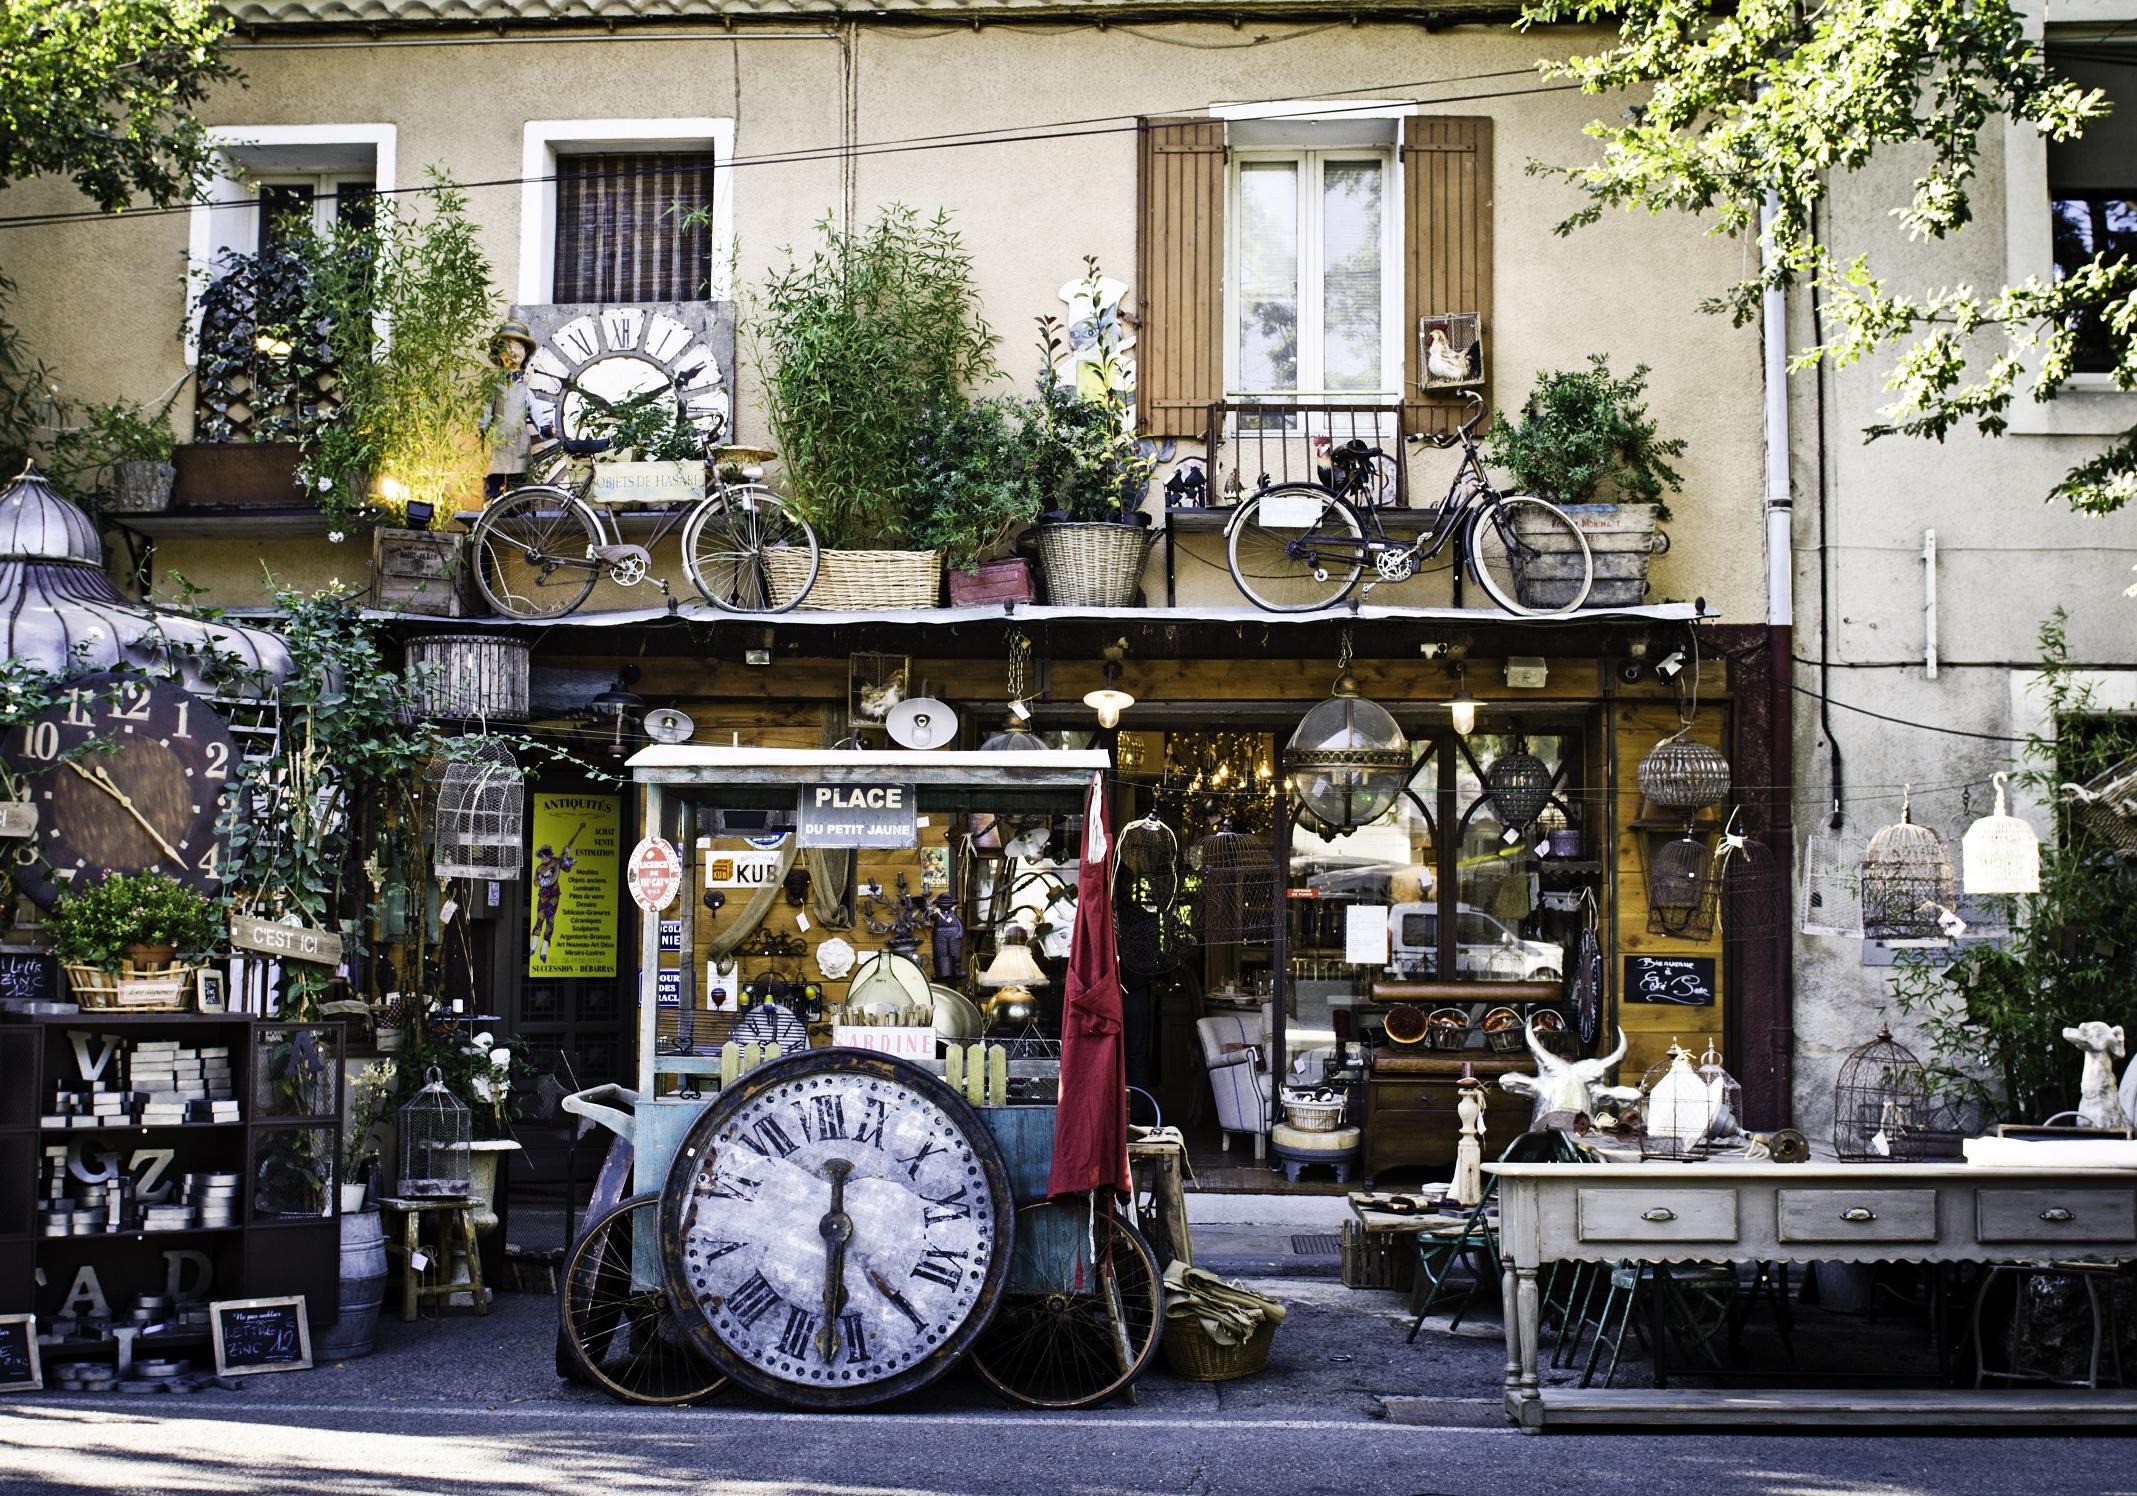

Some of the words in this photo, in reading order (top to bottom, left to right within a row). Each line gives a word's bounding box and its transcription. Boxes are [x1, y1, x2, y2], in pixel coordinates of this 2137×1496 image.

[637, 475, 652, 488] DE
[172, 701, 192, 739] 1
[18, 719, 59, 761] 10
[205, 742, 230, 780] 2
[544, 798, 612, 813] ANTIQUITÉS
[815, 788, 902, 808] PLACE
[806, 824, 825, 834] DU
[827, 825, 865, 835] PETIT
[867, 825, 910, 836] JAUNE
[198, 842, 221, 879] 4
[575, 849, 615, 857] ESTIMATION
[713, 871, 727, 880] KUB
[736, 864, 778, 884] KUB
[253, 927, 294, 949] C'EST
[300, 934, 318, 954] ICI
[1637, 957, 1695, 969] Bienvenue
[833, 1033, 932, 1054] SARDINE
[66, 1030, 121, 1081] V
[67, 1136, 122, 1185] G
[128, 1149, 175, 1206] Z
[57, 1265, 112, 1318] A
[163, 1250, 213, 1304] D
